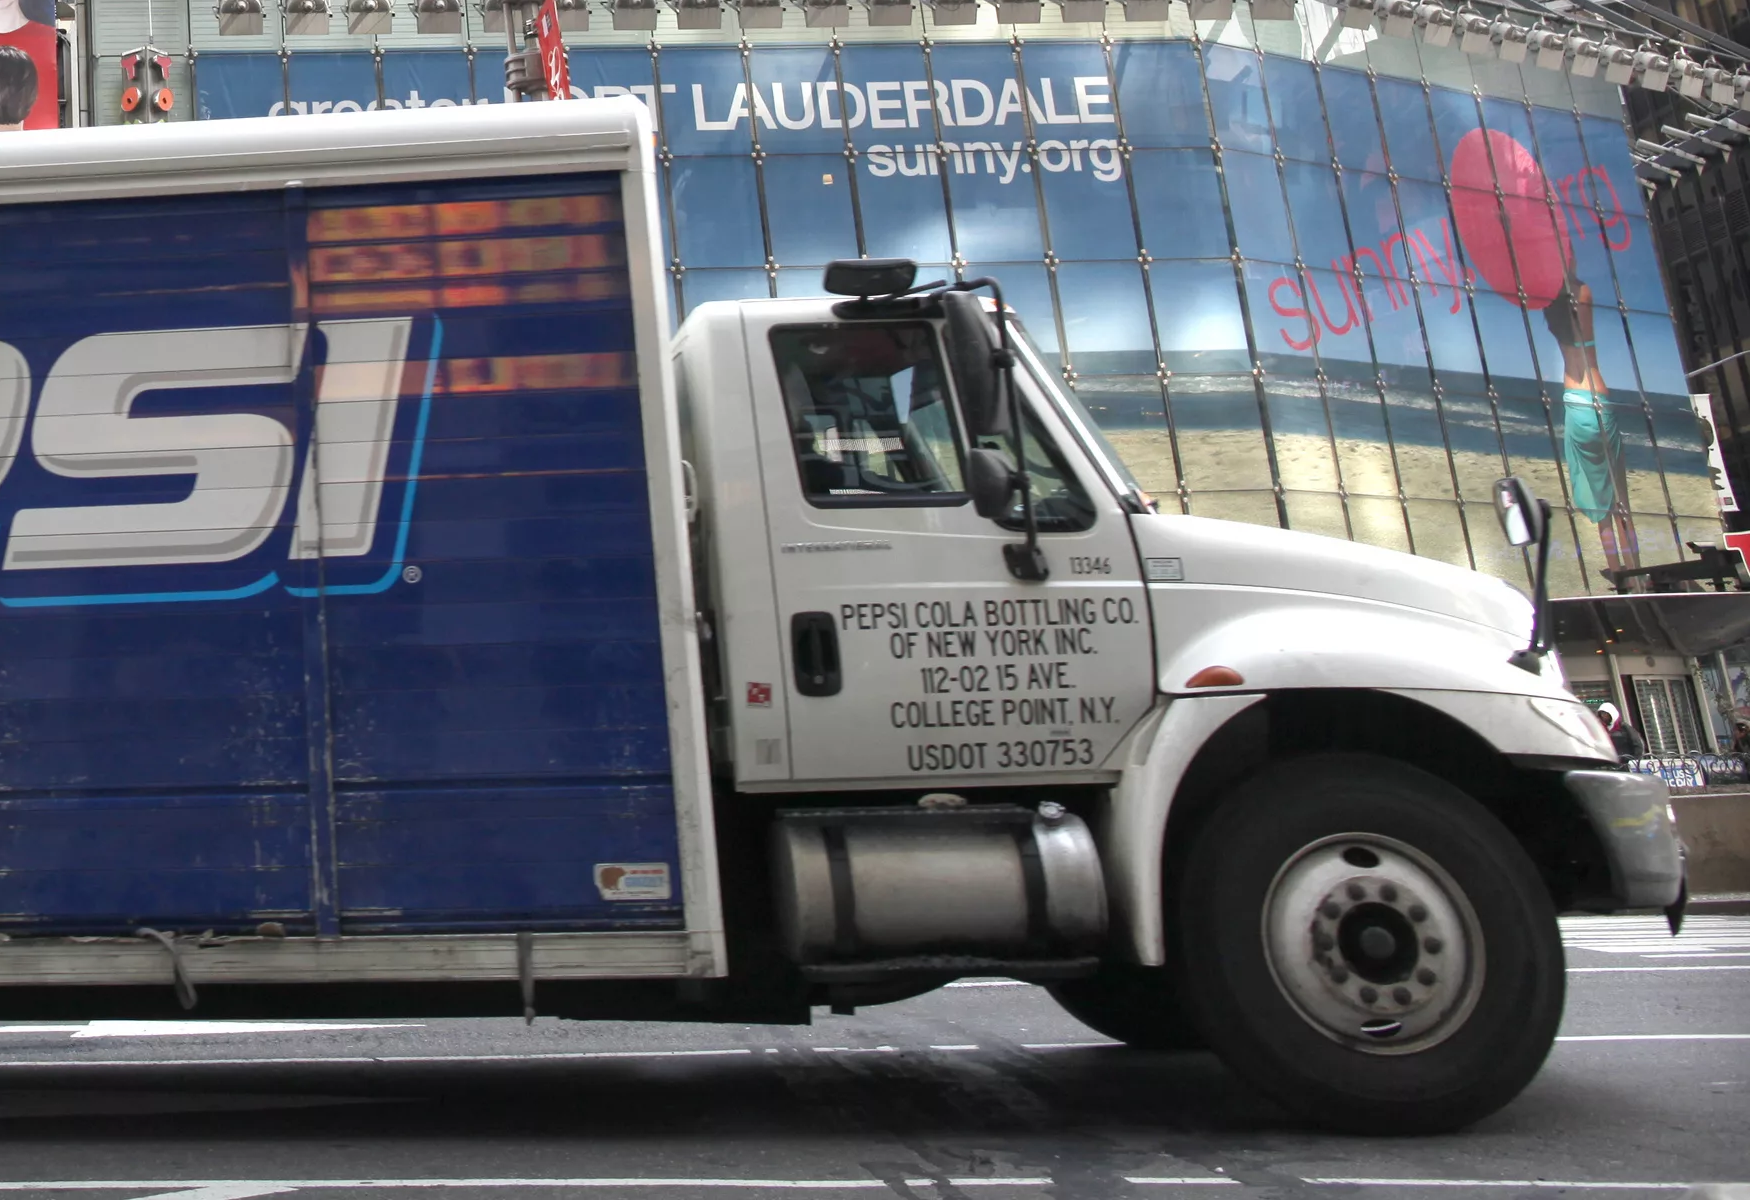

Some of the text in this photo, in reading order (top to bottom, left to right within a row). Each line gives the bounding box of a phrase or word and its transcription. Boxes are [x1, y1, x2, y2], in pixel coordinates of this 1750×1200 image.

[691, 76, 1116, 131] LAUDERDALE
[867, 136, 1123, 185] sunny.org
[1267, 162, 1633, 351] sunny.rg
[1069, 557, 1113, 576] 13346
[841, 596, 1140, 631] PEPSI COLA BOTTLING CO.
[890, 628, 1099, 660] OF NEW YORK INC.
[920, 661, 1077, 694] 112-02 15 AVE.
[890, 700, 996, 729] COLLEGE
[1080, 696, 1120, 725] N.Y.
[907, 738, 1095, 772] USDOT 330753
